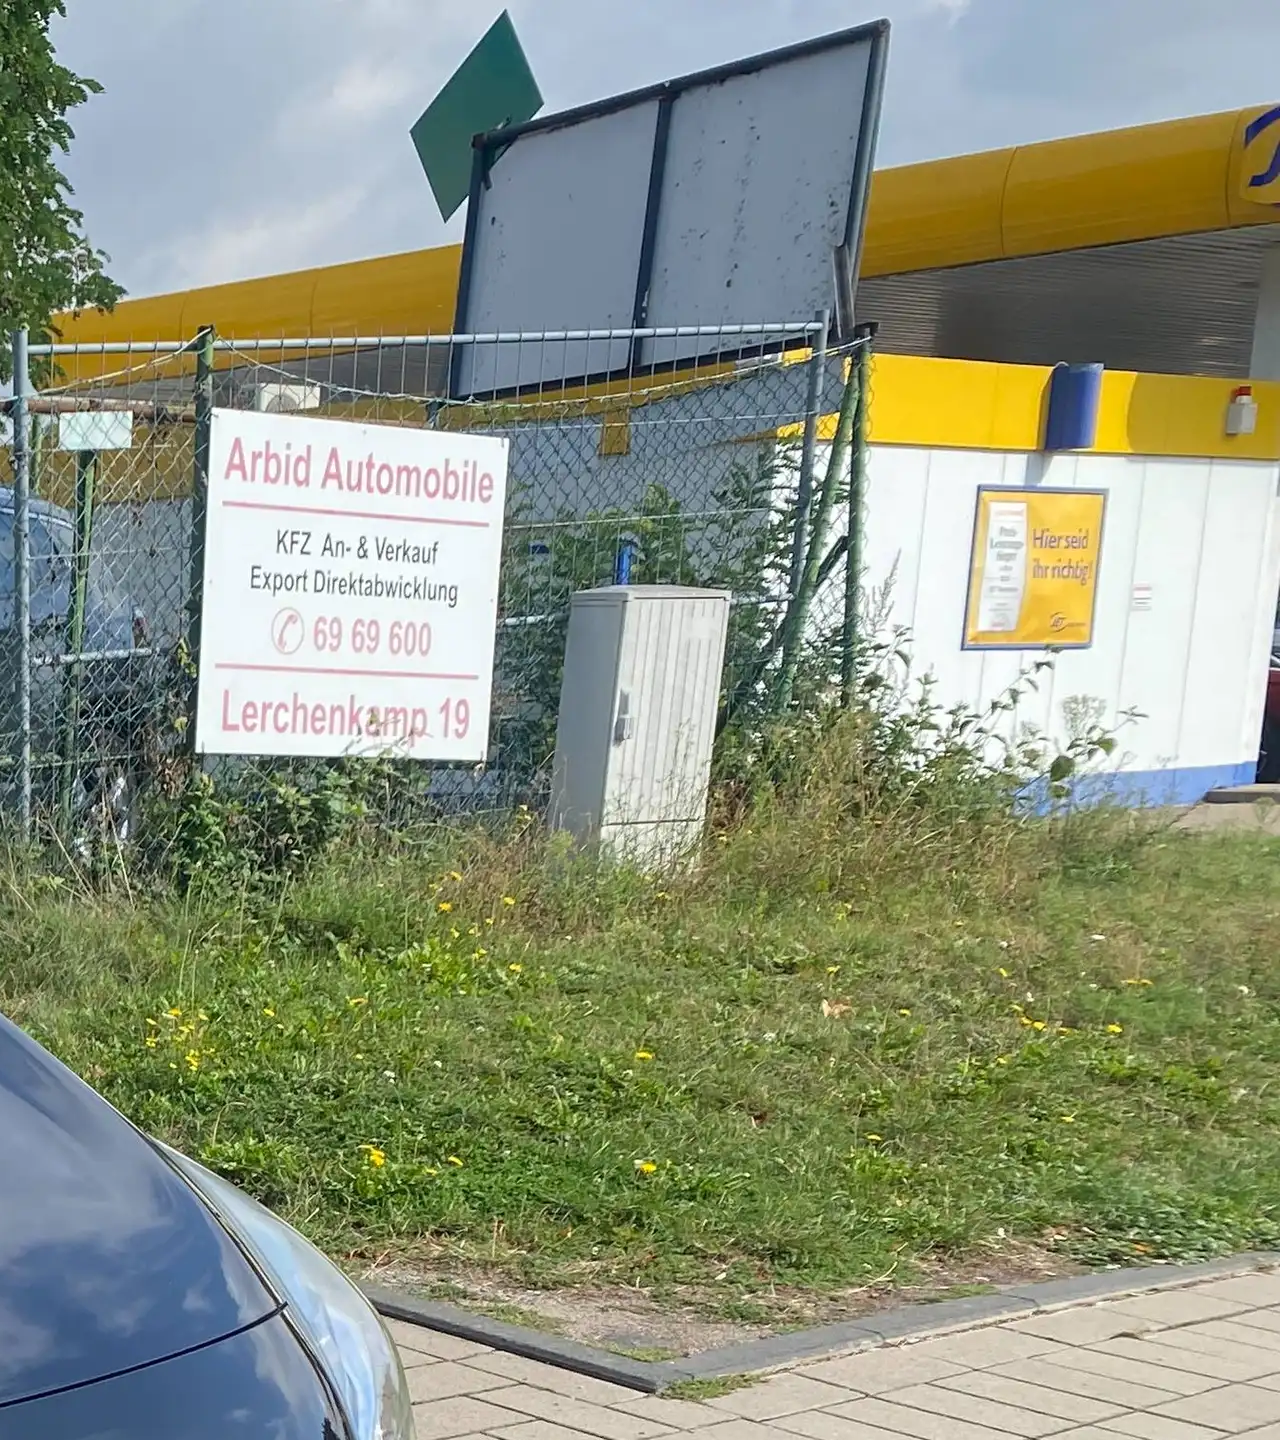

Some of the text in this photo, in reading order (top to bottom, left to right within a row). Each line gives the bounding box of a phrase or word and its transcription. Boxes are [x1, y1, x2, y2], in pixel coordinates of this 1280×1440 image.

[224, 436, 494, 503] Arbid Automobile
[276, 529, 439, 565] KFZ An- & Verkauf
[1032, 528, 1062, 549] Hier
[1064, 528, 1089, 549] seid
[250, 566, 459, 608] Export Direktabwicklung
[1032, 558, 1093, 586] ihr richtig!
[313, 616, 432, 657] 69 69 600
[221, 689, 470, 746] Lerchenkamp 19
